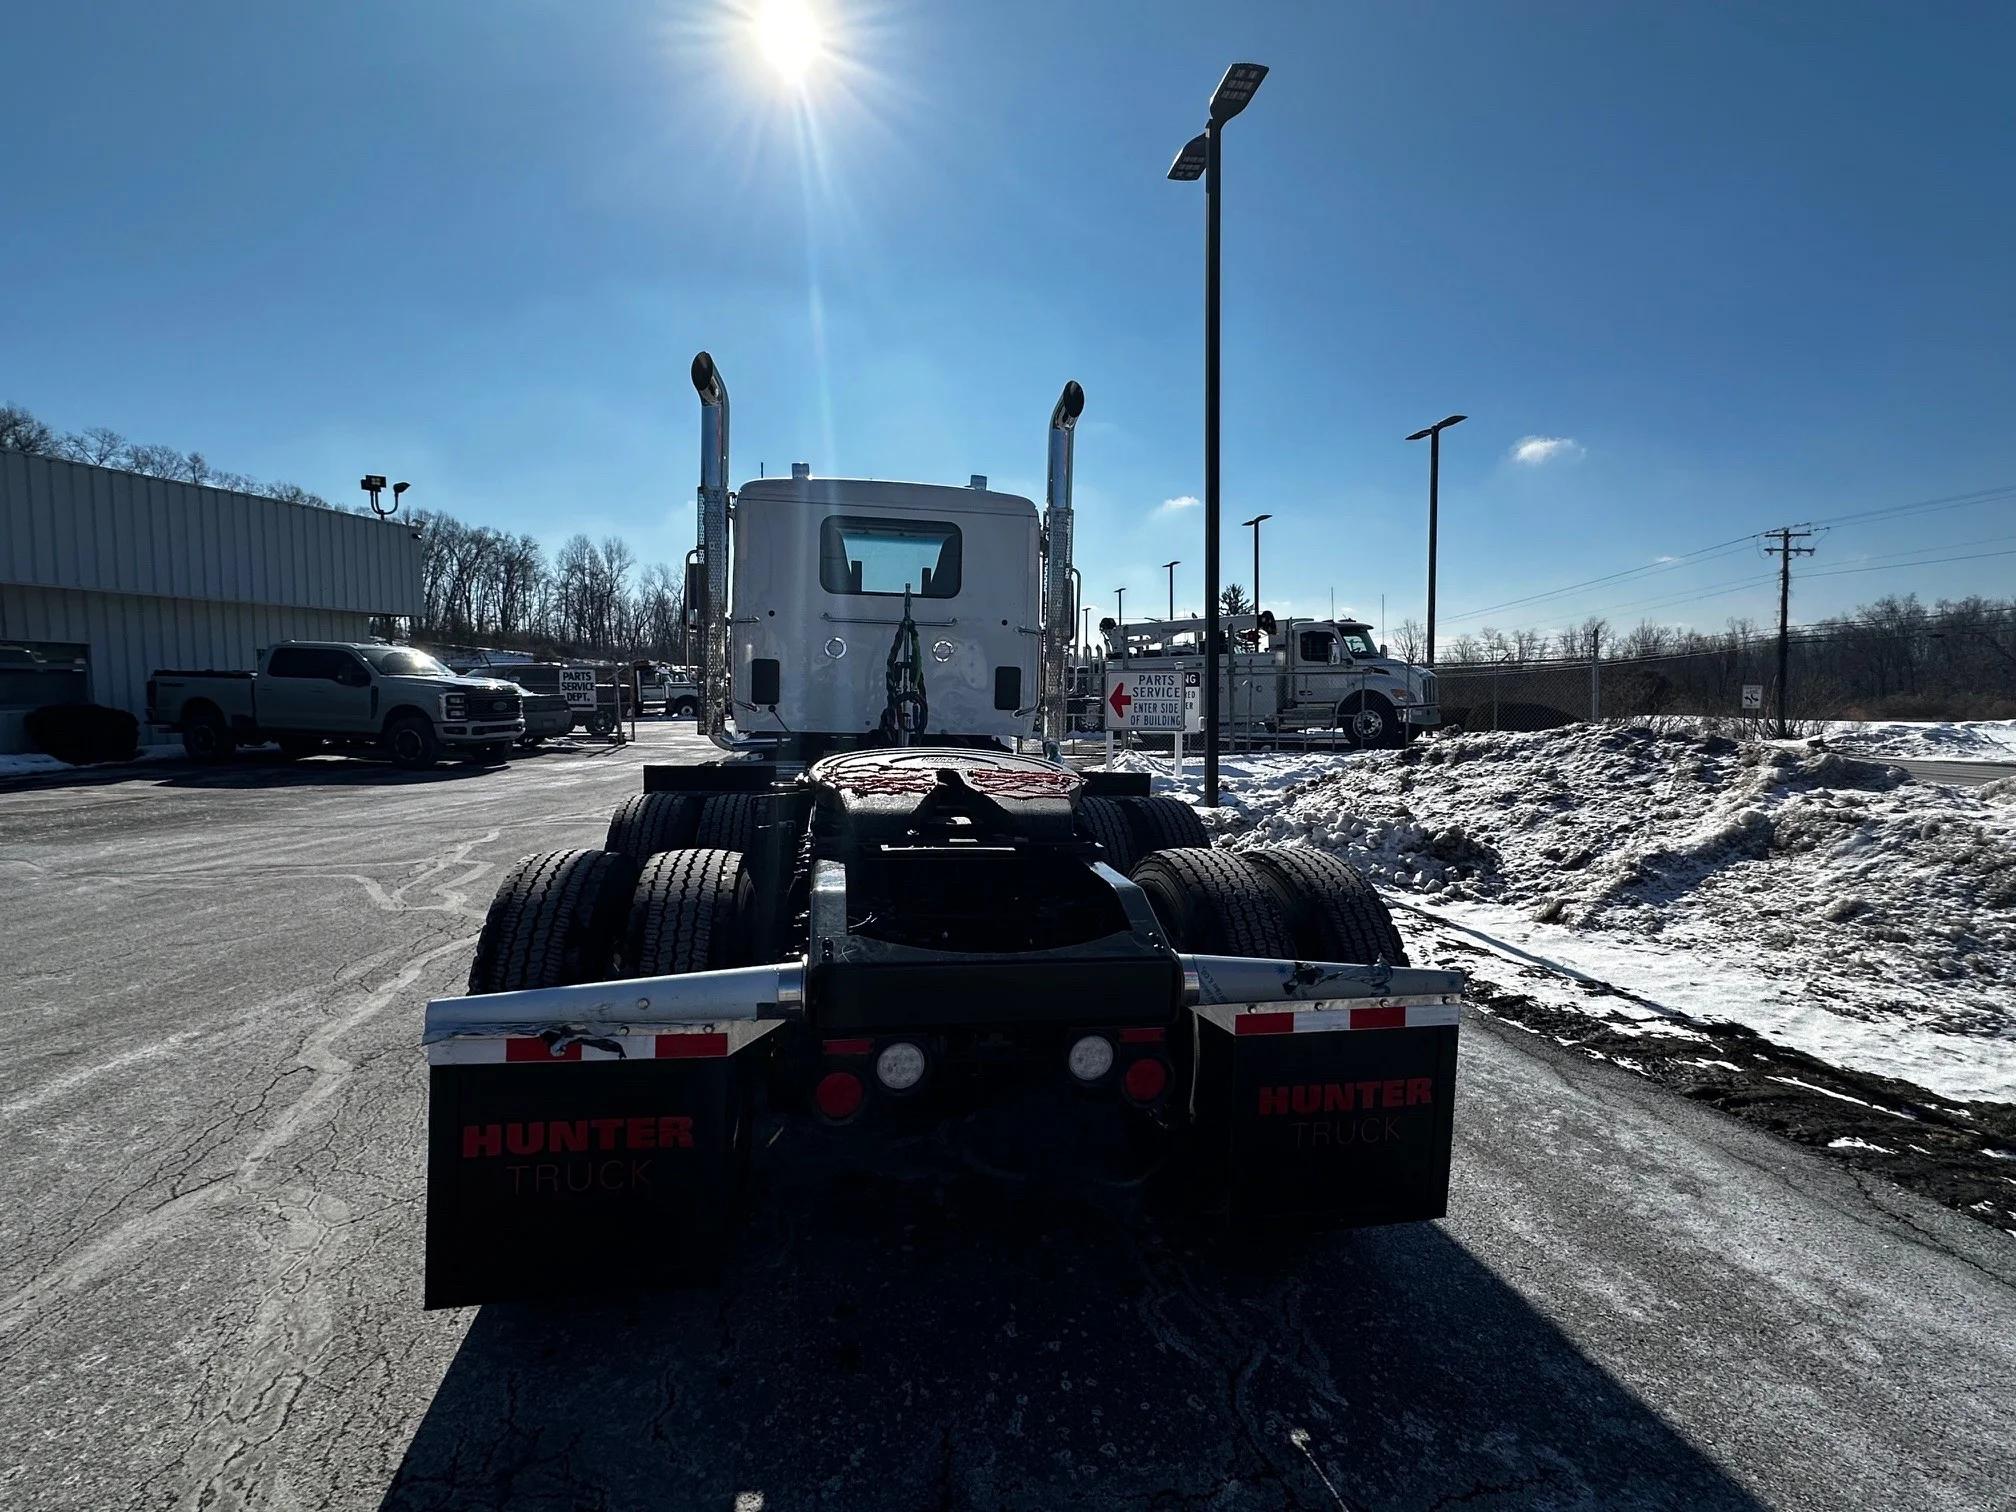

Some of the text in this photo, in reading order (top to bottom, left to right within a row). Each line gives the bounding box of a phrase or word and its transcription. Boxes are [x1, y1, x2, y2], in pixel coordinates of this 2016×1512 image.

[563, 672, 592, 680] PARTS
[1138, 675, 1175, 685] PARTS
[561, 682, 595, 690] SERVICE
[567, 692, 590, 701] DEPT.
[1132, 687, 1180, 697] SERVICE
[1133, 702, 1178, 713] ENTER SIDE
[1130, 715, 1181, 726] OF BUILDING
[1258, 1077, 1432, 1116] HUNTER
[1288, 1115, 1401, 1148] TRUCK
[462, 1115, 695, 1160] HUNTER
[505, 1160, 656, 1197] TRUCK
